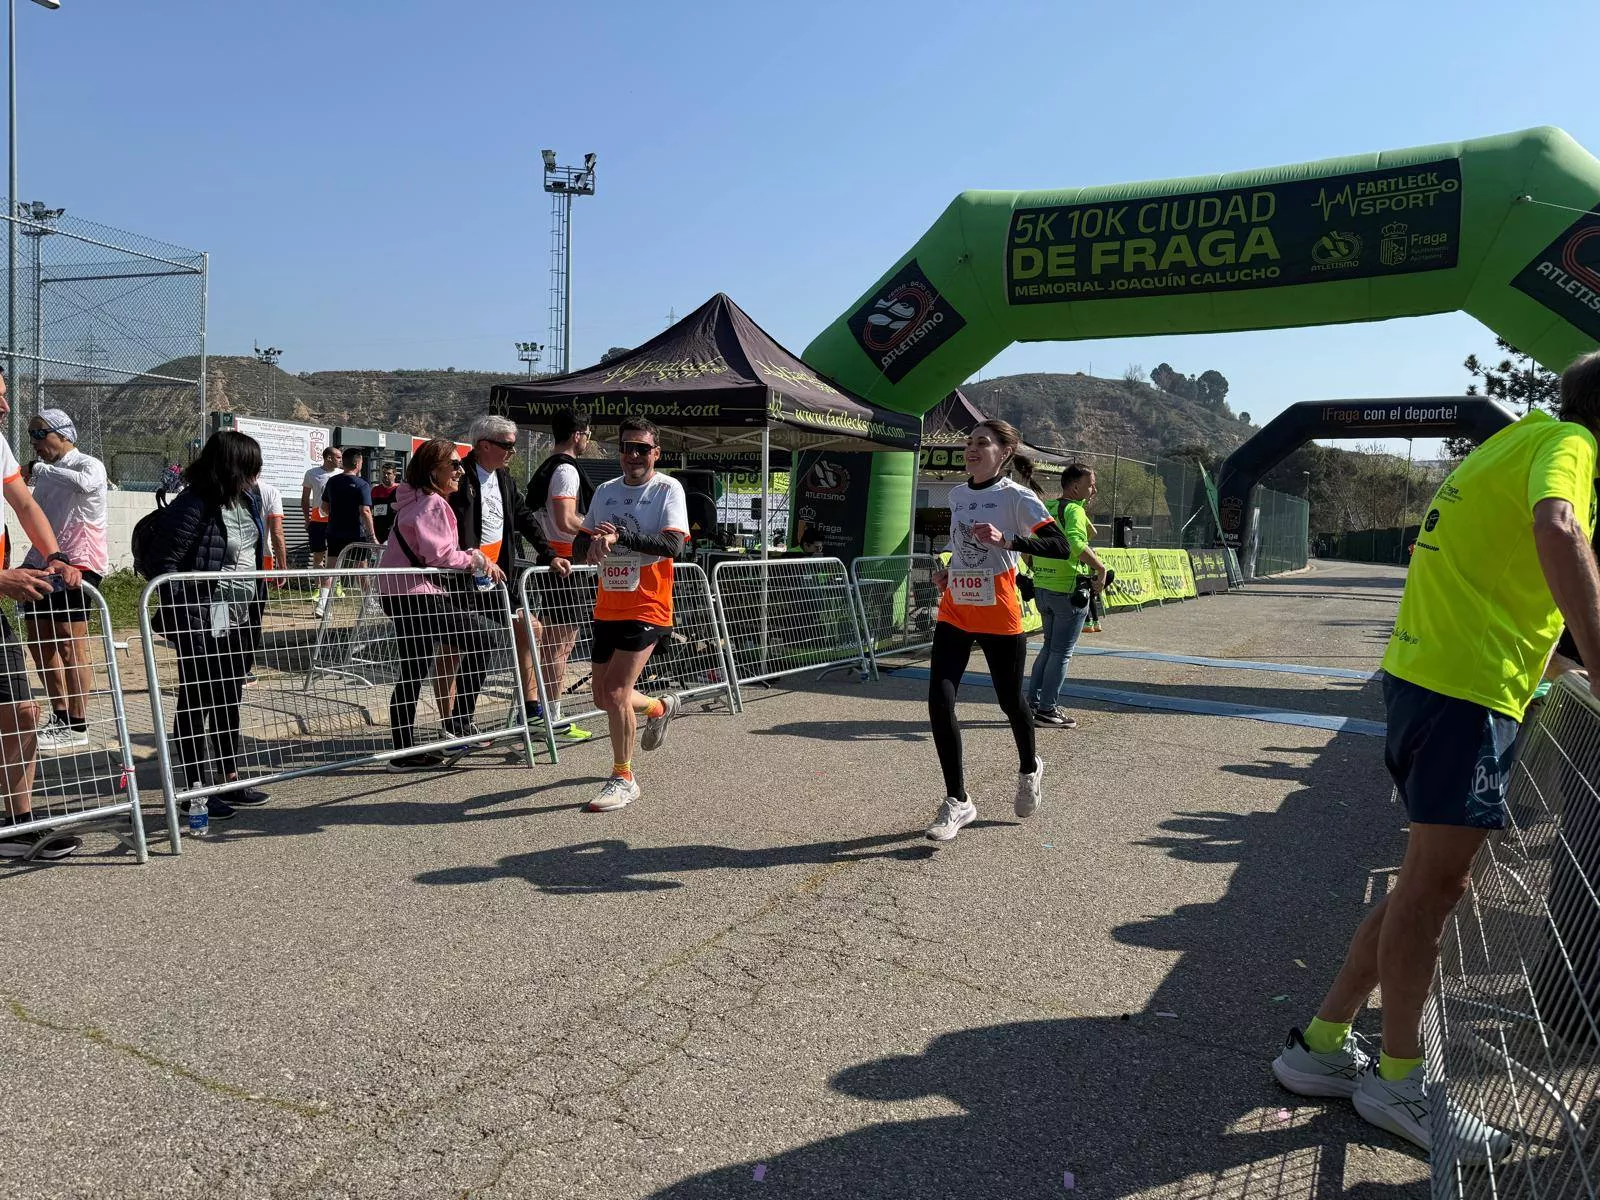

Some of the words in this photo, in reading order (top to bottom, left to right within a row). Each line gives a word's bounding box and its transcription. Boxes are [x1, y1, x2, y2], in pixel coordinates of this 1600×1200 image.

[1357, 172, 1438, 196] FARTLECK
[1361, 190, 1439, 215] SPORT
[1014, 213, 1059, 244] 5K
[1068, 206, 1129, 240] 10K
[1137, 191, 1277, 233] CIUDAD
[1411, 233, 1448, 246] Fraga
[1012, 244, 1077, 280] DE
[1091, 226, 1281, 276] FRAGA
[1014, 281, 1105, 297] MEMORIAL
[1108, 272, 1187, 291] JOAQUÍN
[1190, 266, 1281, 287] CALUCHO
[1536, 261, 1600, 314] ATLETIS
[526, 395, 720, 418] wwwfartlecksport.com
[1363, 409, 1385, 420] con
[1390, 406, 1400, 419] el
[1405, 405, 1458, 422] deporte!
[795, 409, 907, 438] www.fartlecksport.com
[818, 522, 842, 534] Fraga
[952, 577, 982, 588] 1108
